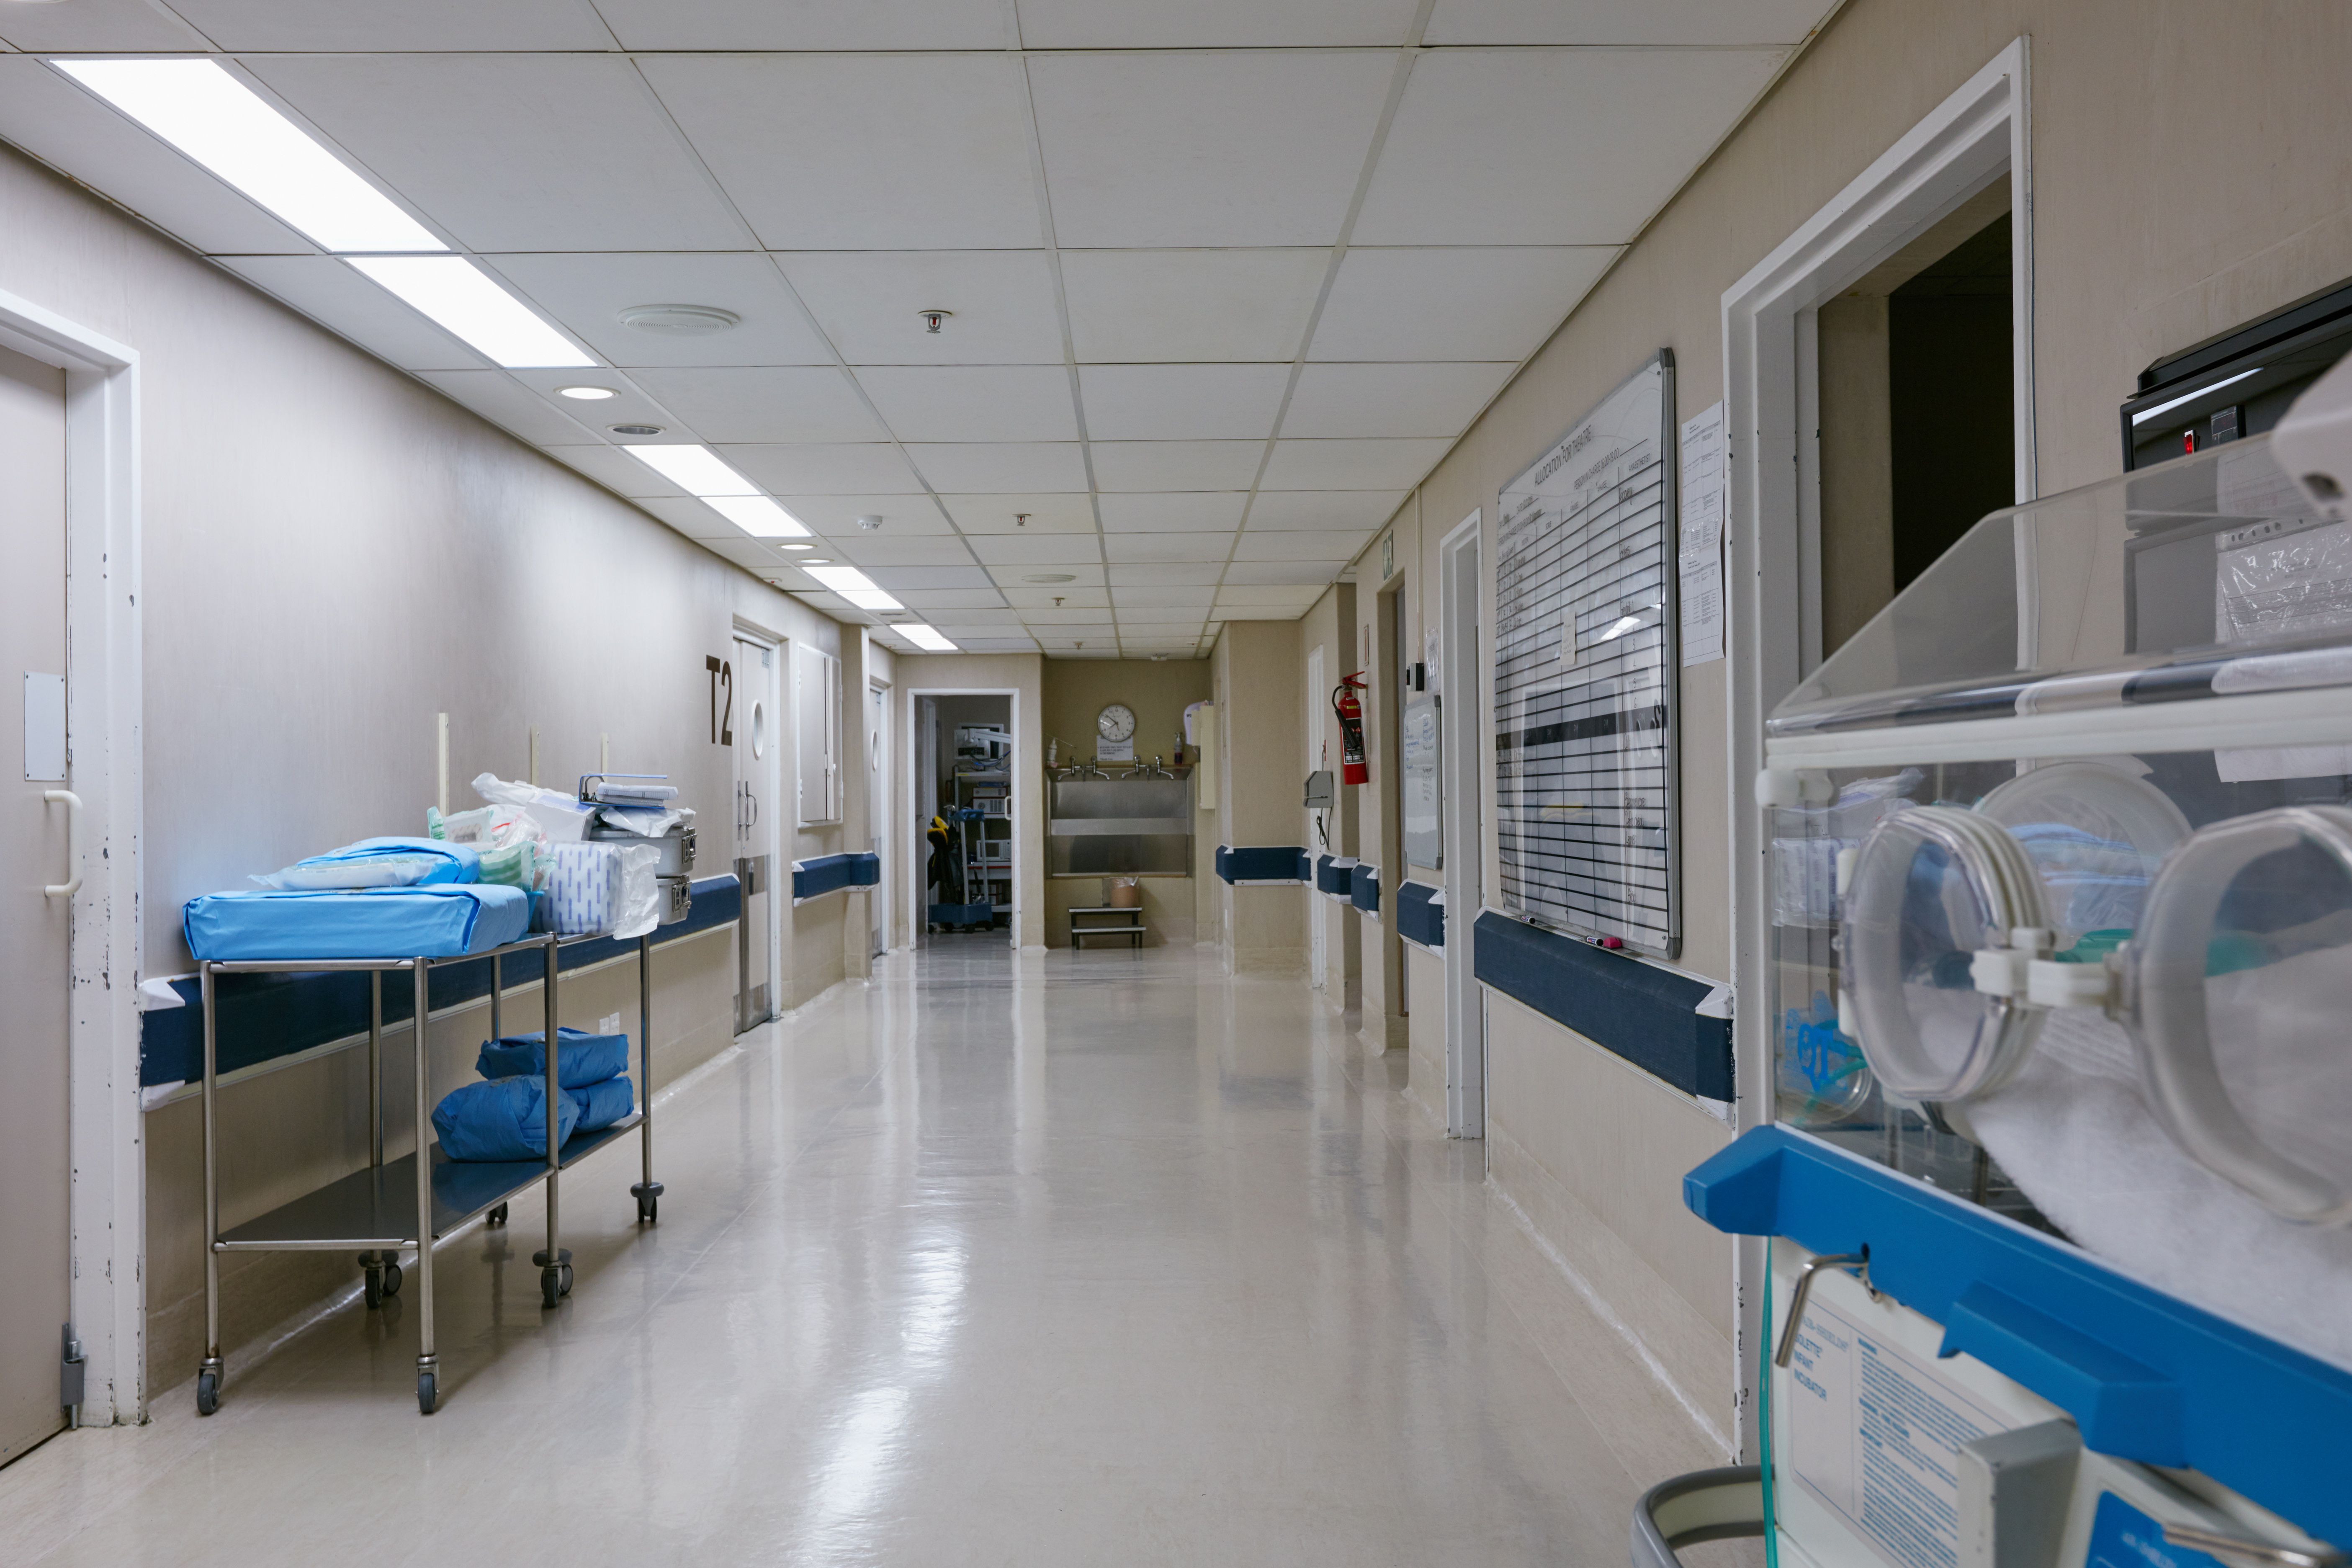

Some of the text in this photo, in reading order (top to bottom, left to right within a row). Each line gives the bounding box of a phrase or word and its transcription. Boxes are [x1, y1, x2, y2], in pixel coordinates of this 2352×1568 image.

[1534, 425, 1591, 487] ALLOCATION FOR THEATRE
[1629, 453, 1651, 472] ANAESTHETIST
[1574, 475, 1585, 491] PERSON
[1588, 461, 1601, 482] CHARGE
[706, 654, 732, 746] T2
[1794, 1349, 1814, 1371] INFANT
[1794, 1368, 1827, 1401] INCUBATOR
